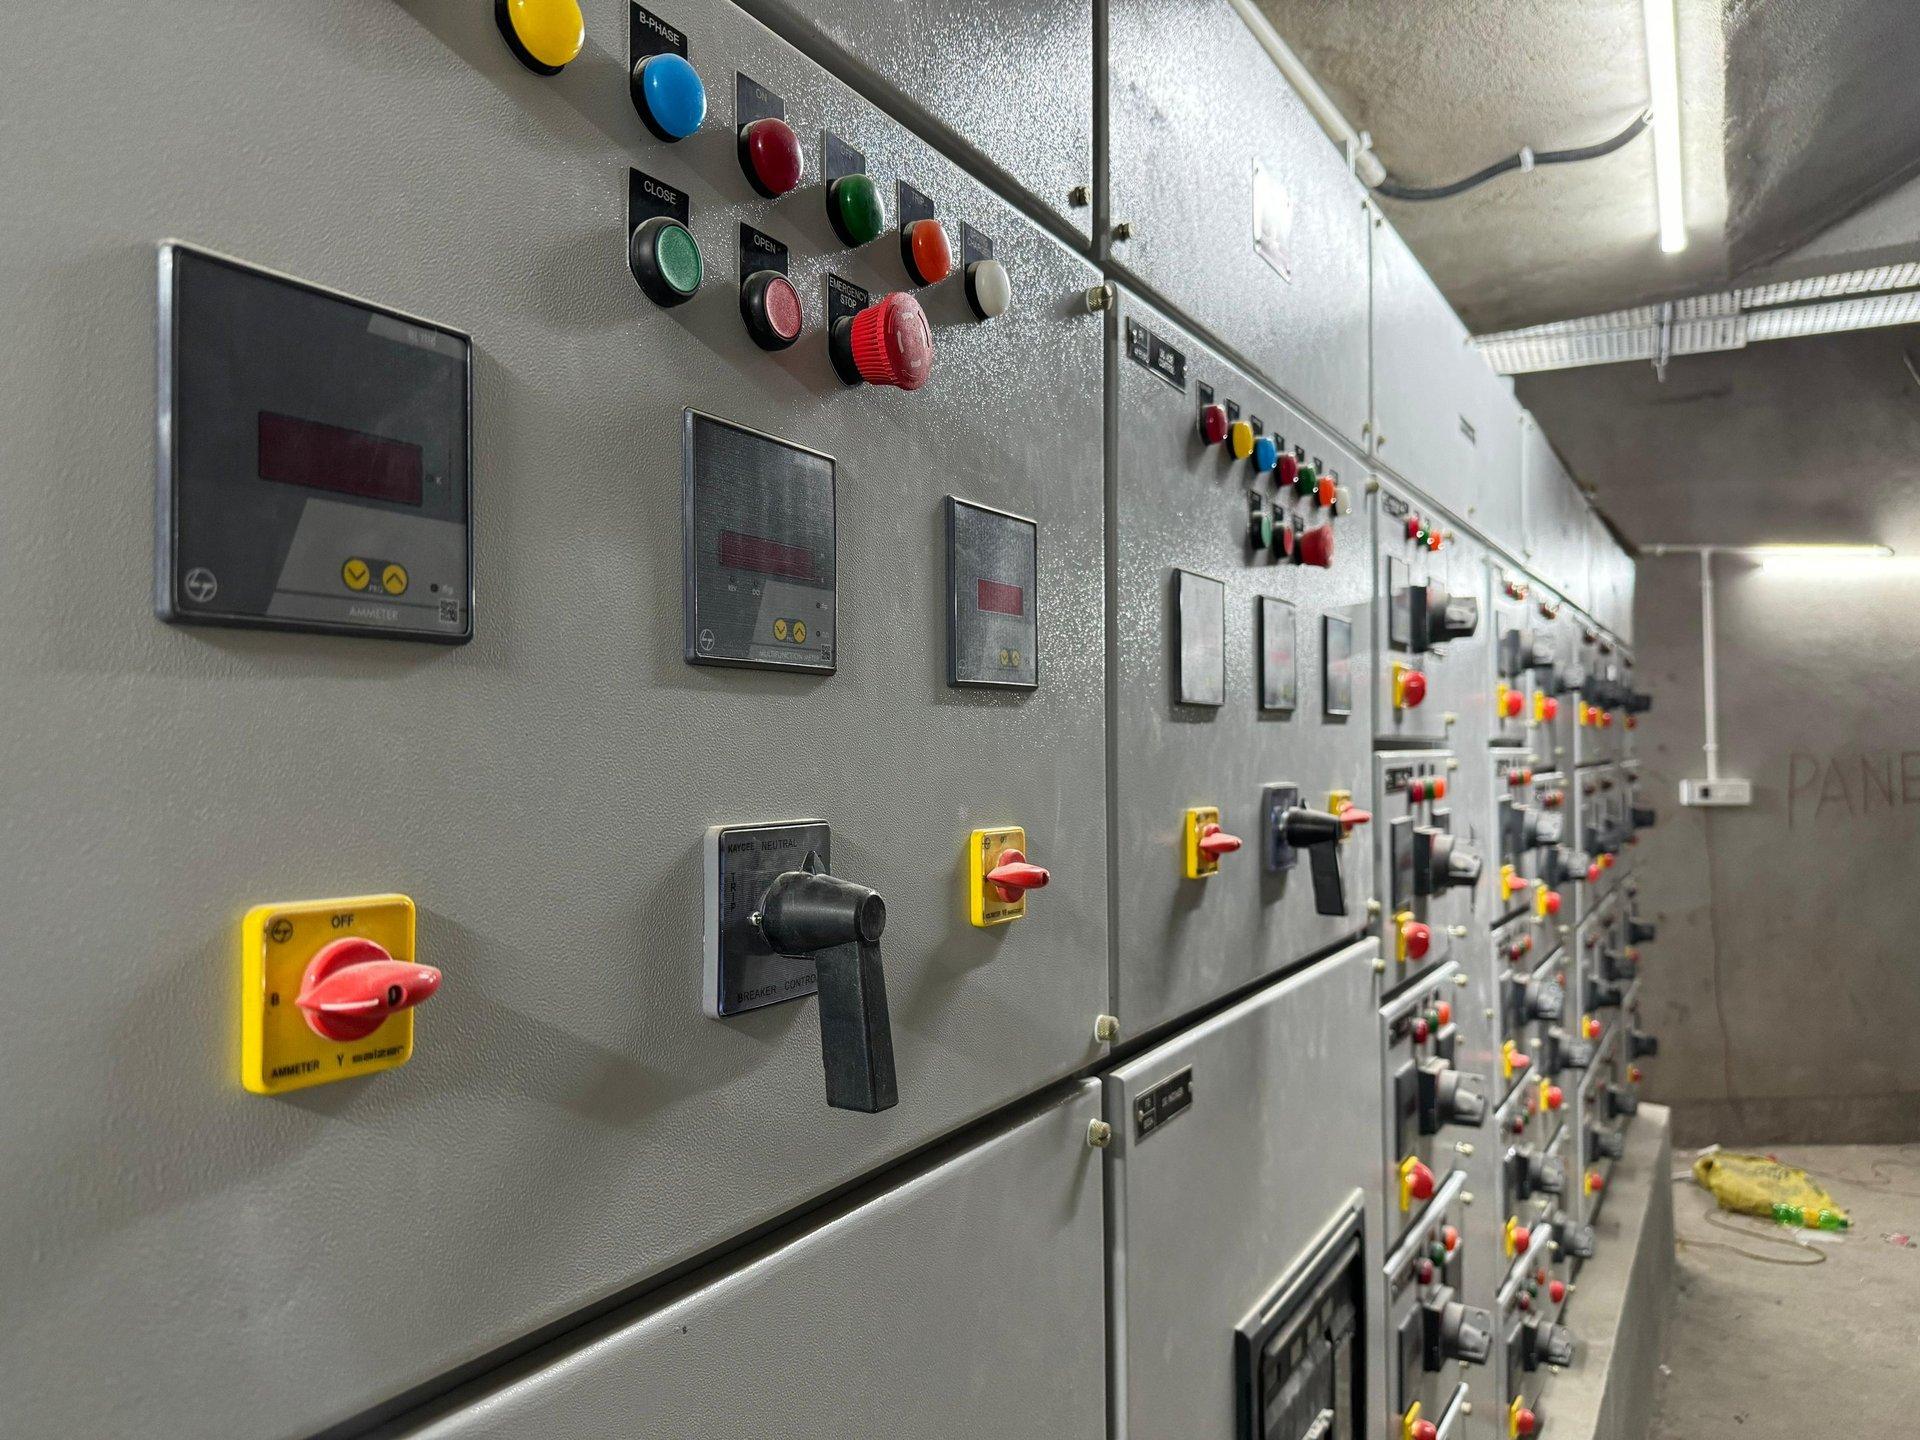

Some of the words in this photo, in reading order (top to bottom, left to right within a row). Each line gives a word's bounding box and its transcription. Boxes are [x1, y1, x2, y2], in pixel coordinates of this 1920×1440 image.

[639, 11, 681, 47] B-PHASE
[756, 88, 768, 103] ON
[644, 180, 677, 205] CLOSE
[753, 234, 776, 254] OPEN
[829, 275, 868, 303] EMERGENCY
[839, 293, 858, 309] STOP
[761, 838, 798, 851] NEUTRAL
[331, 914, 354, 928] OFF
[737, 984, 777, 1003] BREAKER
[784, 974, 817, 991] CONTRO
[271, 1059, 320, 1079] AMMETER
[336, 1053, 344, 1067] Y
